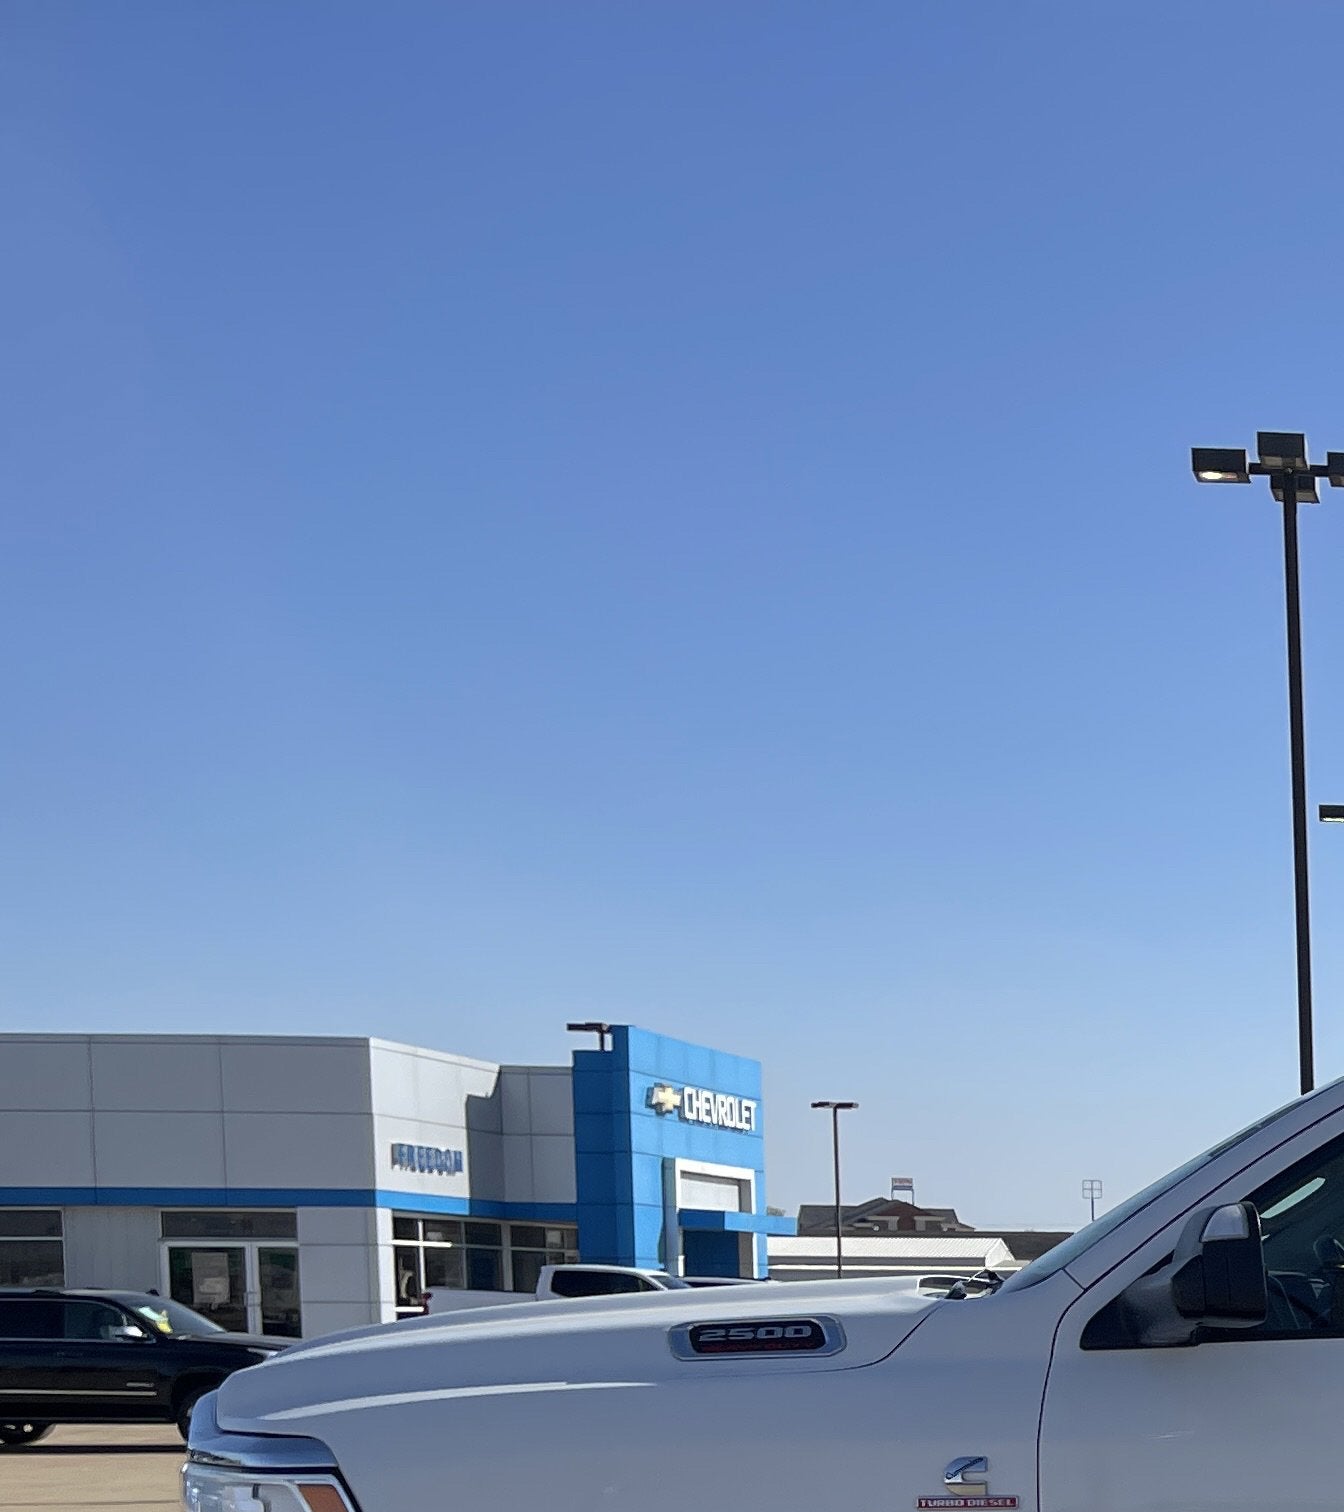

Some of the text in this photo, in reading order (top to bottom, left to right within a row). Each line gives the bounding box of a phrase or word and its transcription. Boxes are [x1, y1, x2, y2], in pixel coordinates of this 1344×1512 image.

[683, 1086, 757, 1131] CHEVROLET
[698, 1325, 812, 1342] 2500
[920, 1499, 1015, 1507] TURBO DIESEL
